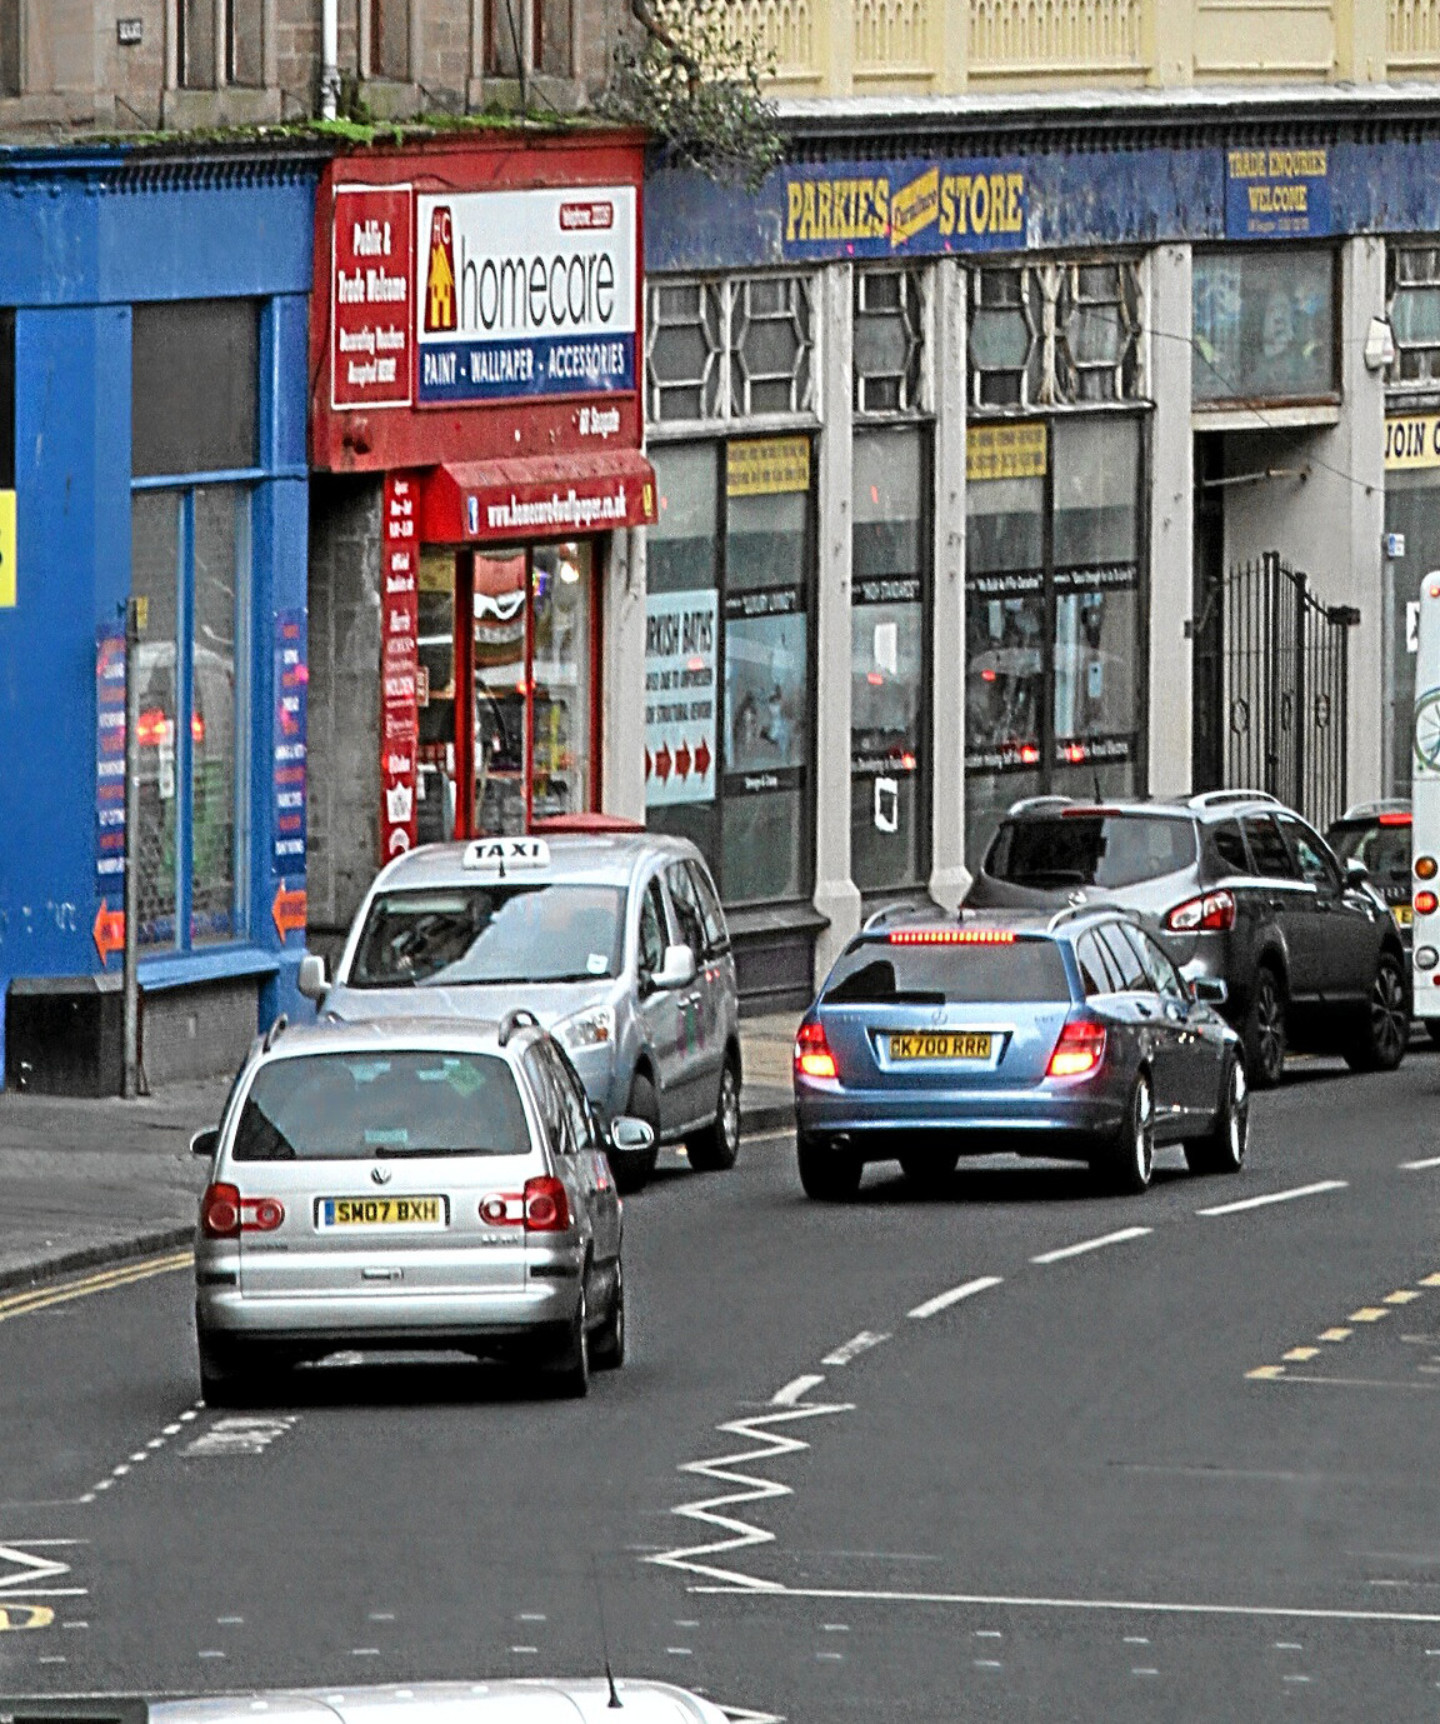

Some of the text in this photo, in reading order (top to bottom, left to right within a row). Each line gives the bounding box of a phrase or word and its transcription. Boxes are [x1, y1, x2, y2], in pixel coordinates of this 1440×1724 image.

[1228, 151, 1266, 178] TRADE
[786, 178, 889, 241] PARKIES
[939, 172, 1024, 236] STORE
[1248, 185, 1308, 212] WELCOME
[353, 219, 382, 256] Public
[339, 266, 407, 304] Trade Welcome
[461, 235, 615, 330] homecare
[424, 343, 625, 386] PAINT WALLPAPER ACCESSORIES
[1386, 421, 1426, 459] JOIN
[475, 843, 540, 857] TAXI
[901, 1038, 988, 1055] K700 RRR
[337, 1202, 438, 1223] SM07 BXH
